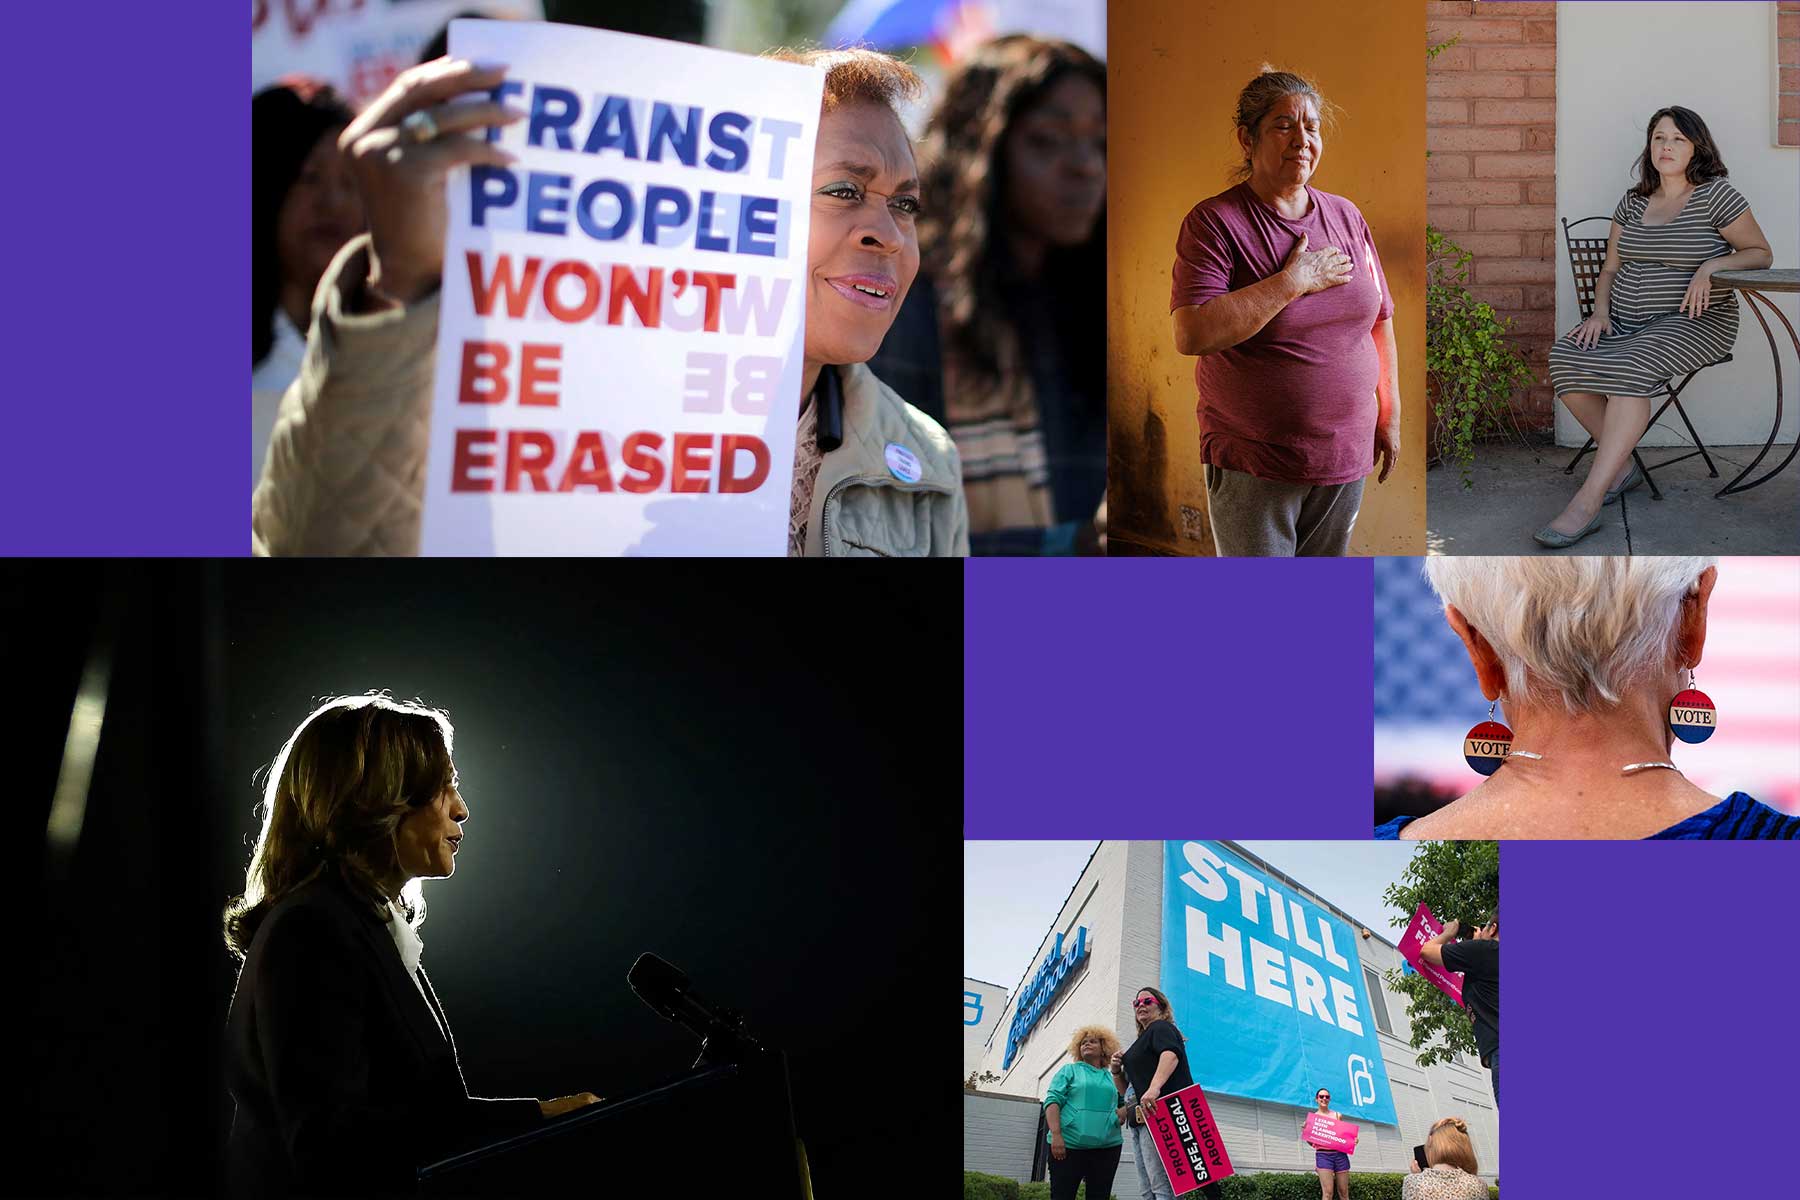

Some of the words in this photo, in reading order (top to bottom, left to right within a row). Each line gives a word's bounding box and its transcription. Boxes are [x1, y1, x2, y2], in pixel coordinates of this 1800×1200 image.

[470, 165, 780, 257] PEOPLE
[458, 340, 563, 407] BE
[450, 428, 771, 494] ERASED
[1674, 708, 1711, 724] VOTE
[1179, 841, 1349, 973] STILL
[1185, 904, 1364, 1037] HERE
[1155, 1116, 1187, 1177] PROTECT
[1170, 1097, 1194, 1142] LEGAL
[1188, 1097, 1223, 1166] ABORTION
[1187, 1142, 1208, 1180] SAFE,
